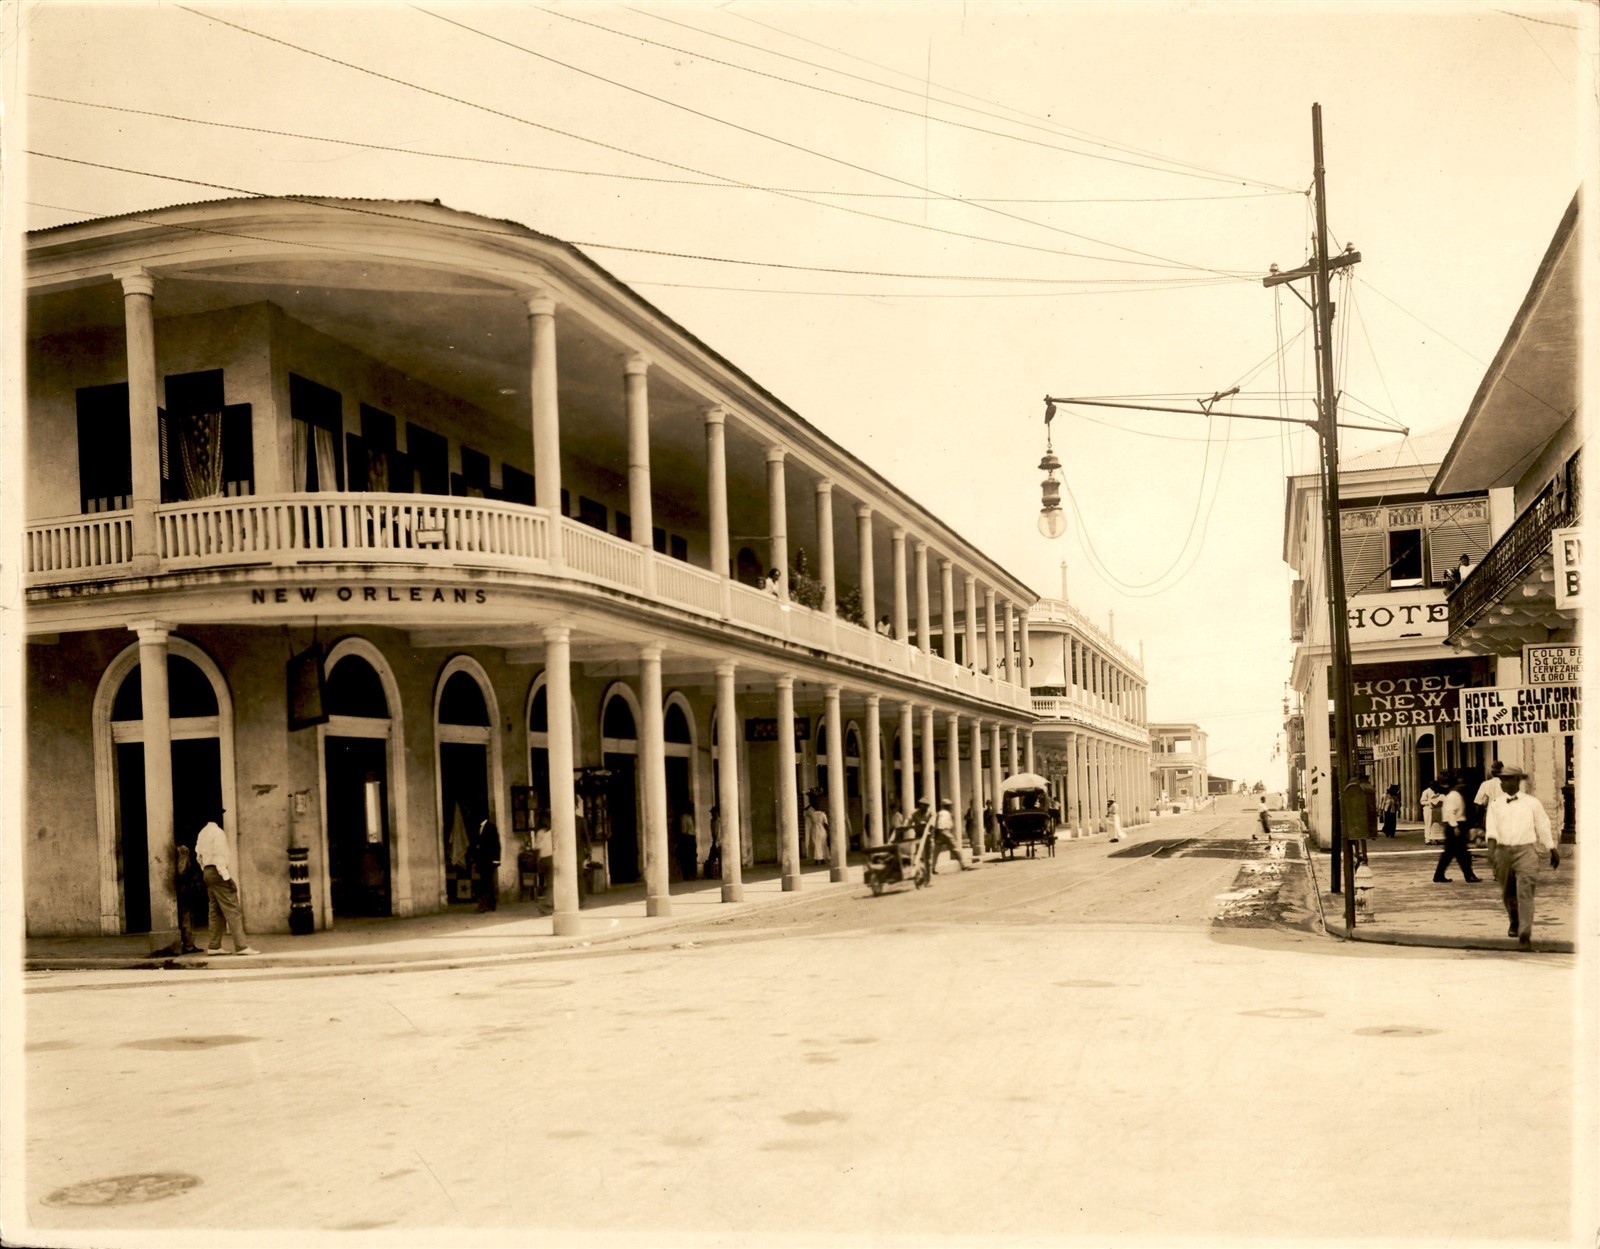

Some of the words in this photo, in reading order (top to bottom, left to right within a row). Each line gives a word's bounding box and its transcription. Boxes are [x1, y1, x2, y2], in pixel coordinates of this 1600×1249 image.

[251, 587, 318, 604] NEW
[336, 586, 487, 604] ORLEANS
[1532, 649, 1563, 658] COLD
[1353, 675, 1465, 696] HOTEL
[1548, 673, 1565, 681] ORO
[1567, 672, 1579, 681] EL
[1370, 691, 1448, 711] NEW
[1465, 691, 1504, 709] HOTEL
[1355, 707, 1461, 728] IMPERIAL
[1465, 708, 1488, 725] BAR
[1492, 708, 1508, 723] AND
[1466, 720, 1549, 738] THEOKTISTON
[1377, 742, 1399, 753] DIXIE
